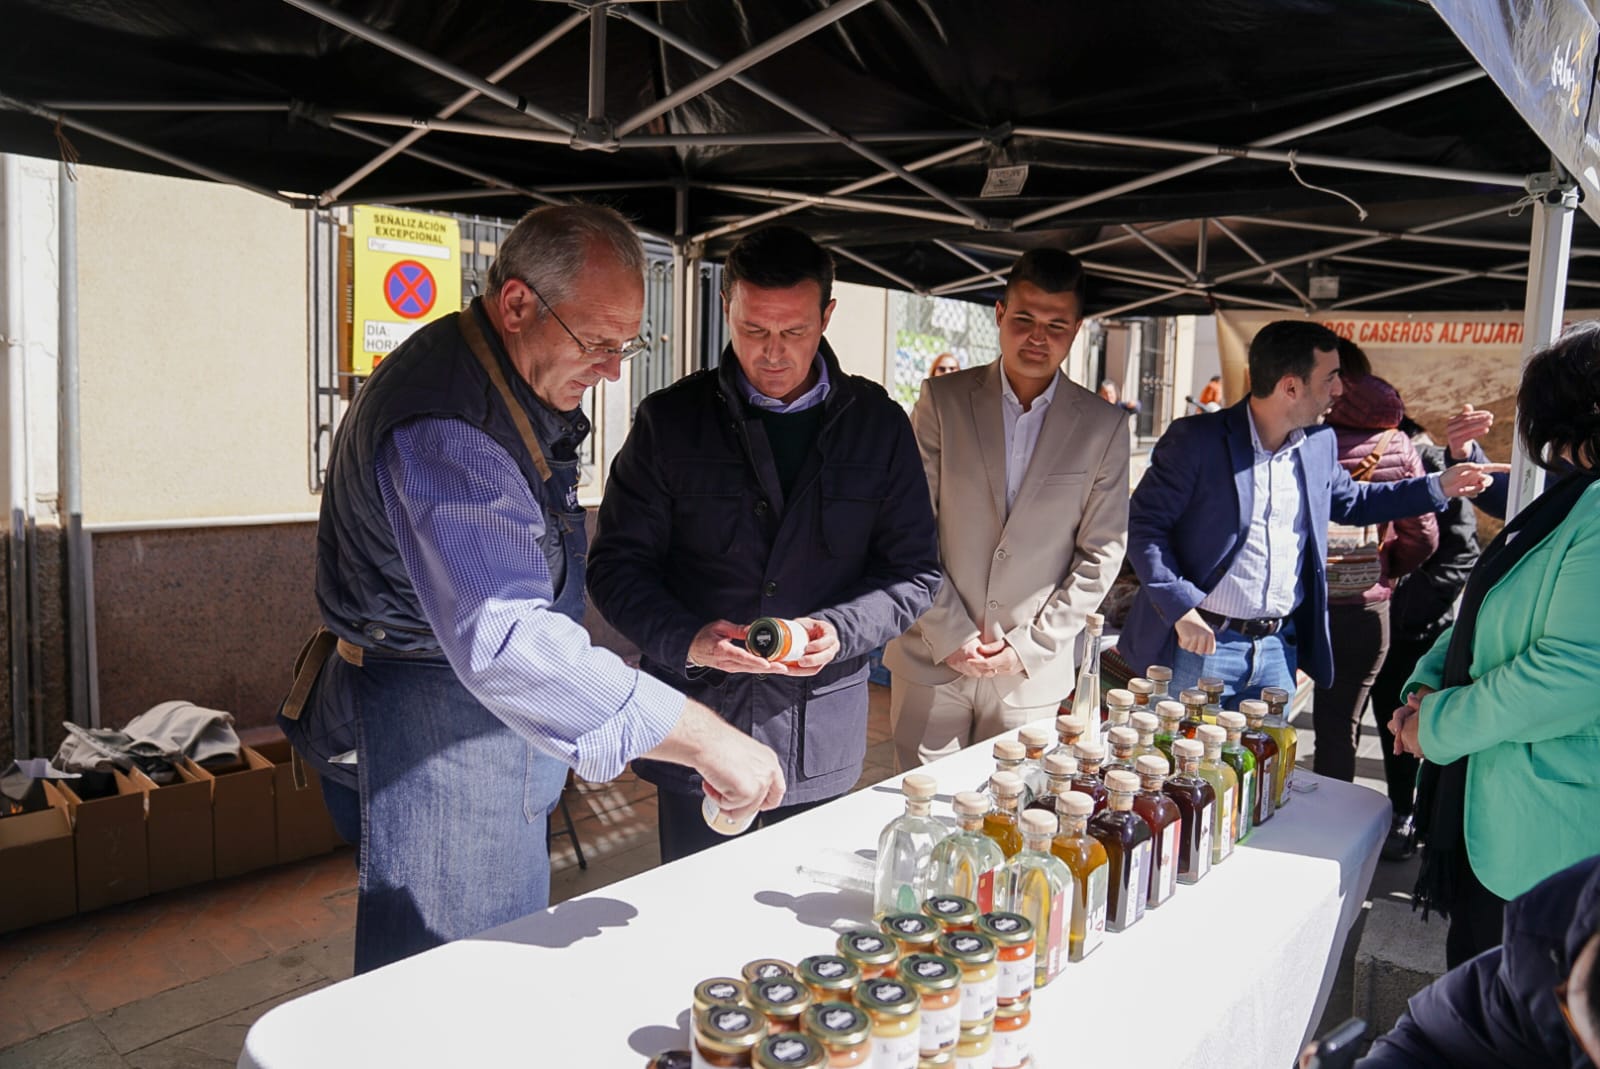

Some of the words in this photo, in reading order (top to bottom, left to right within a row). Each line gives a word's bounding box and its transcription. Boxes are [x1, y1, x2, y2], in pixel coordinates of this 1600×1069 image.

[373, 213, 447, 233] SEÑALIZACIÓN
[375, 226, 443, 244] EXCEPCIONAL
[1359, 320, 1435, 343] CASEROS
